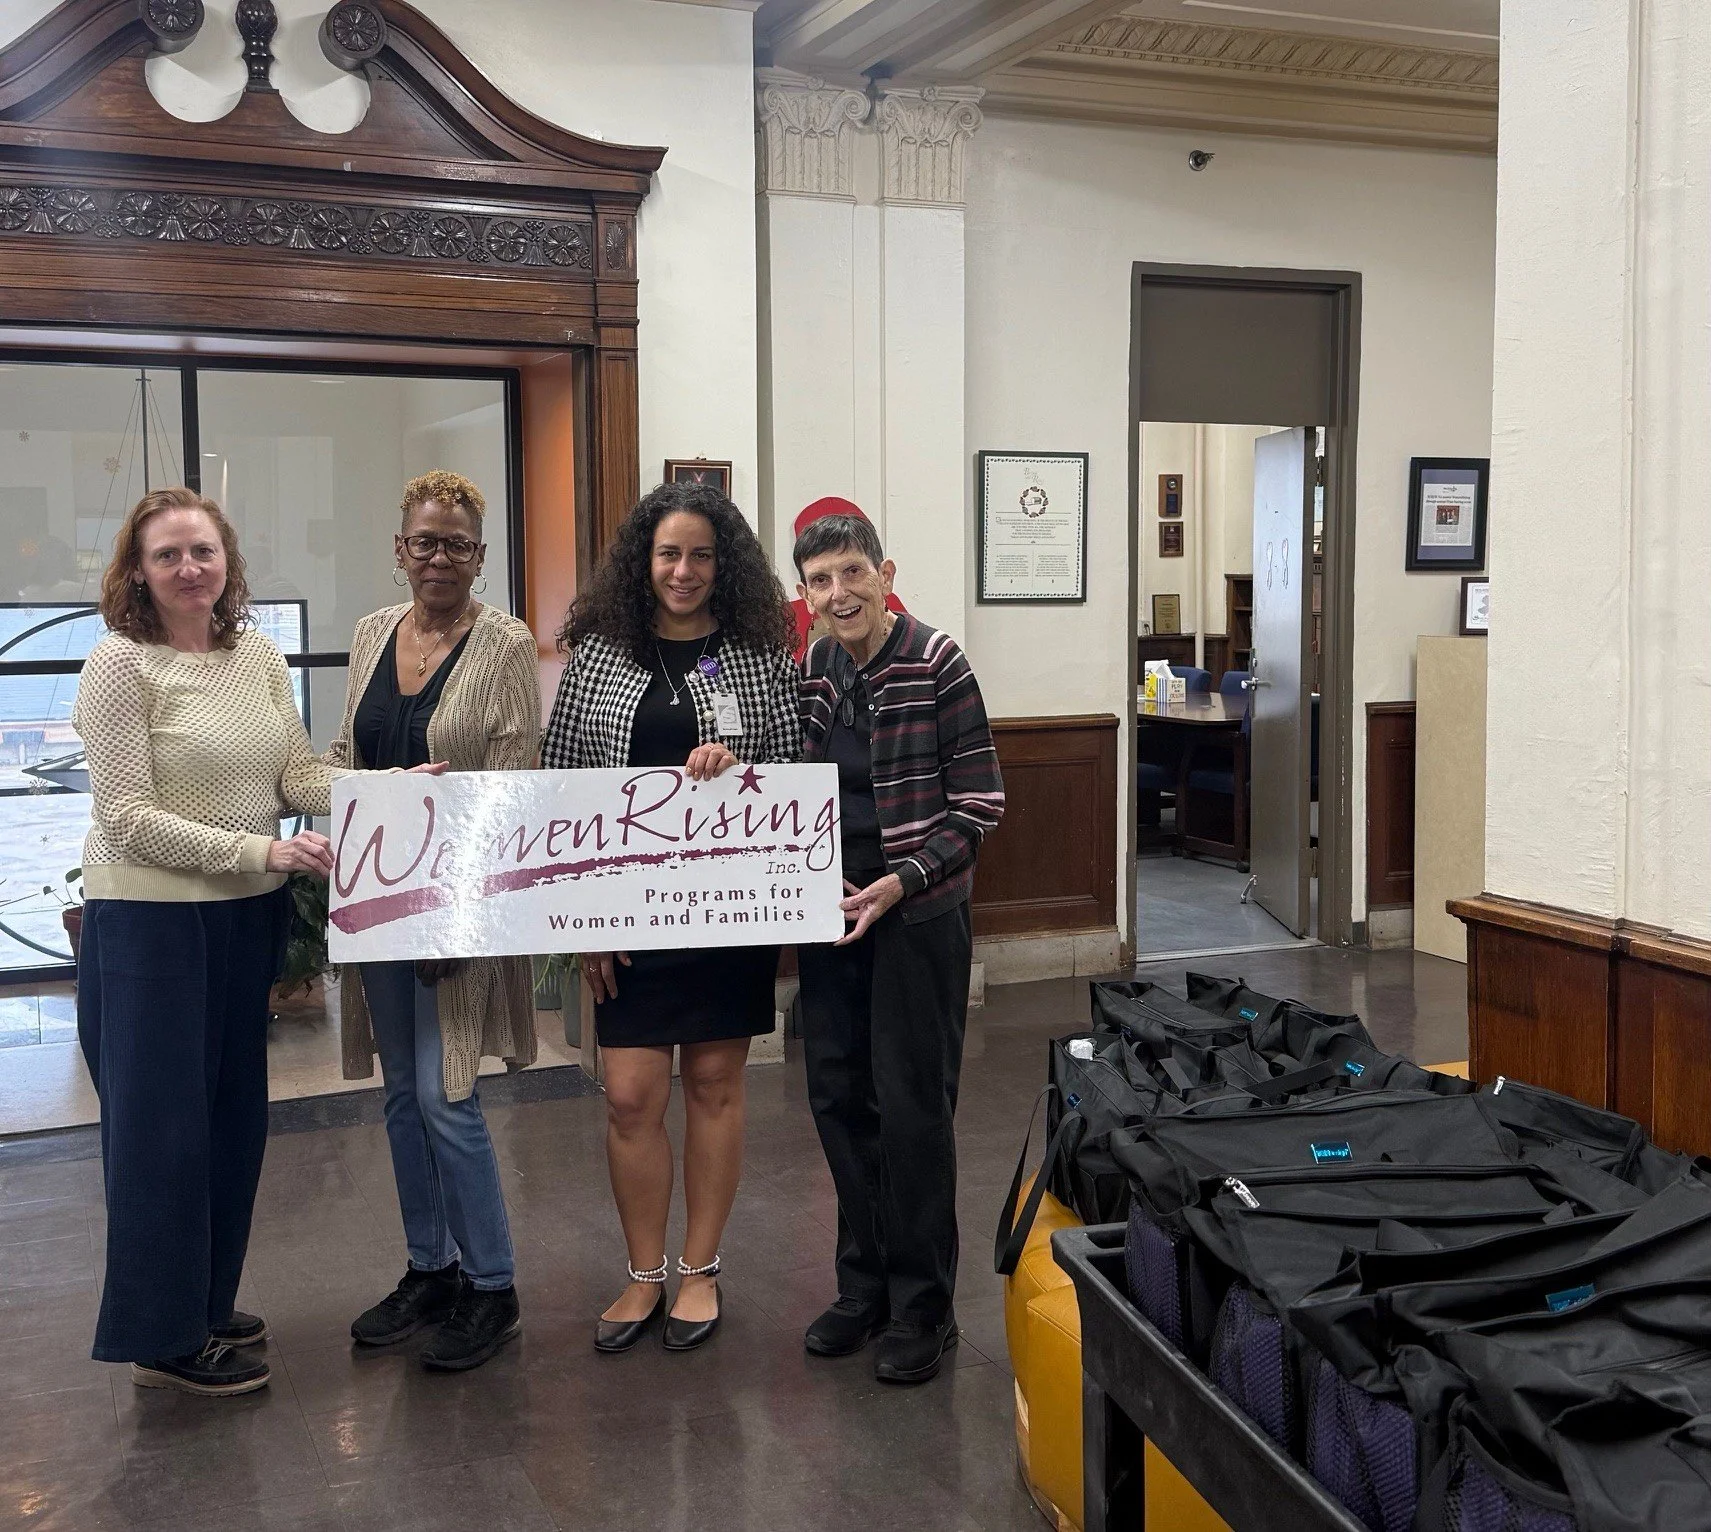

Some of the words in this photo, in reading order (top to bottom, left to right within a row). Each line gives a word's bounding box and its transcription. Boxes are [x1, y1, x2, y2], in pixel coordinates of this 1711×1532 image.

[765, 860, 801, 875] Inc.
[645, 887, 757, 907] Programs
[769, 883, 804, 899] for
[548, 911, 636, 931] Women
[649, 908, 691, 926] and
[705, 906, 805, 924] Families
